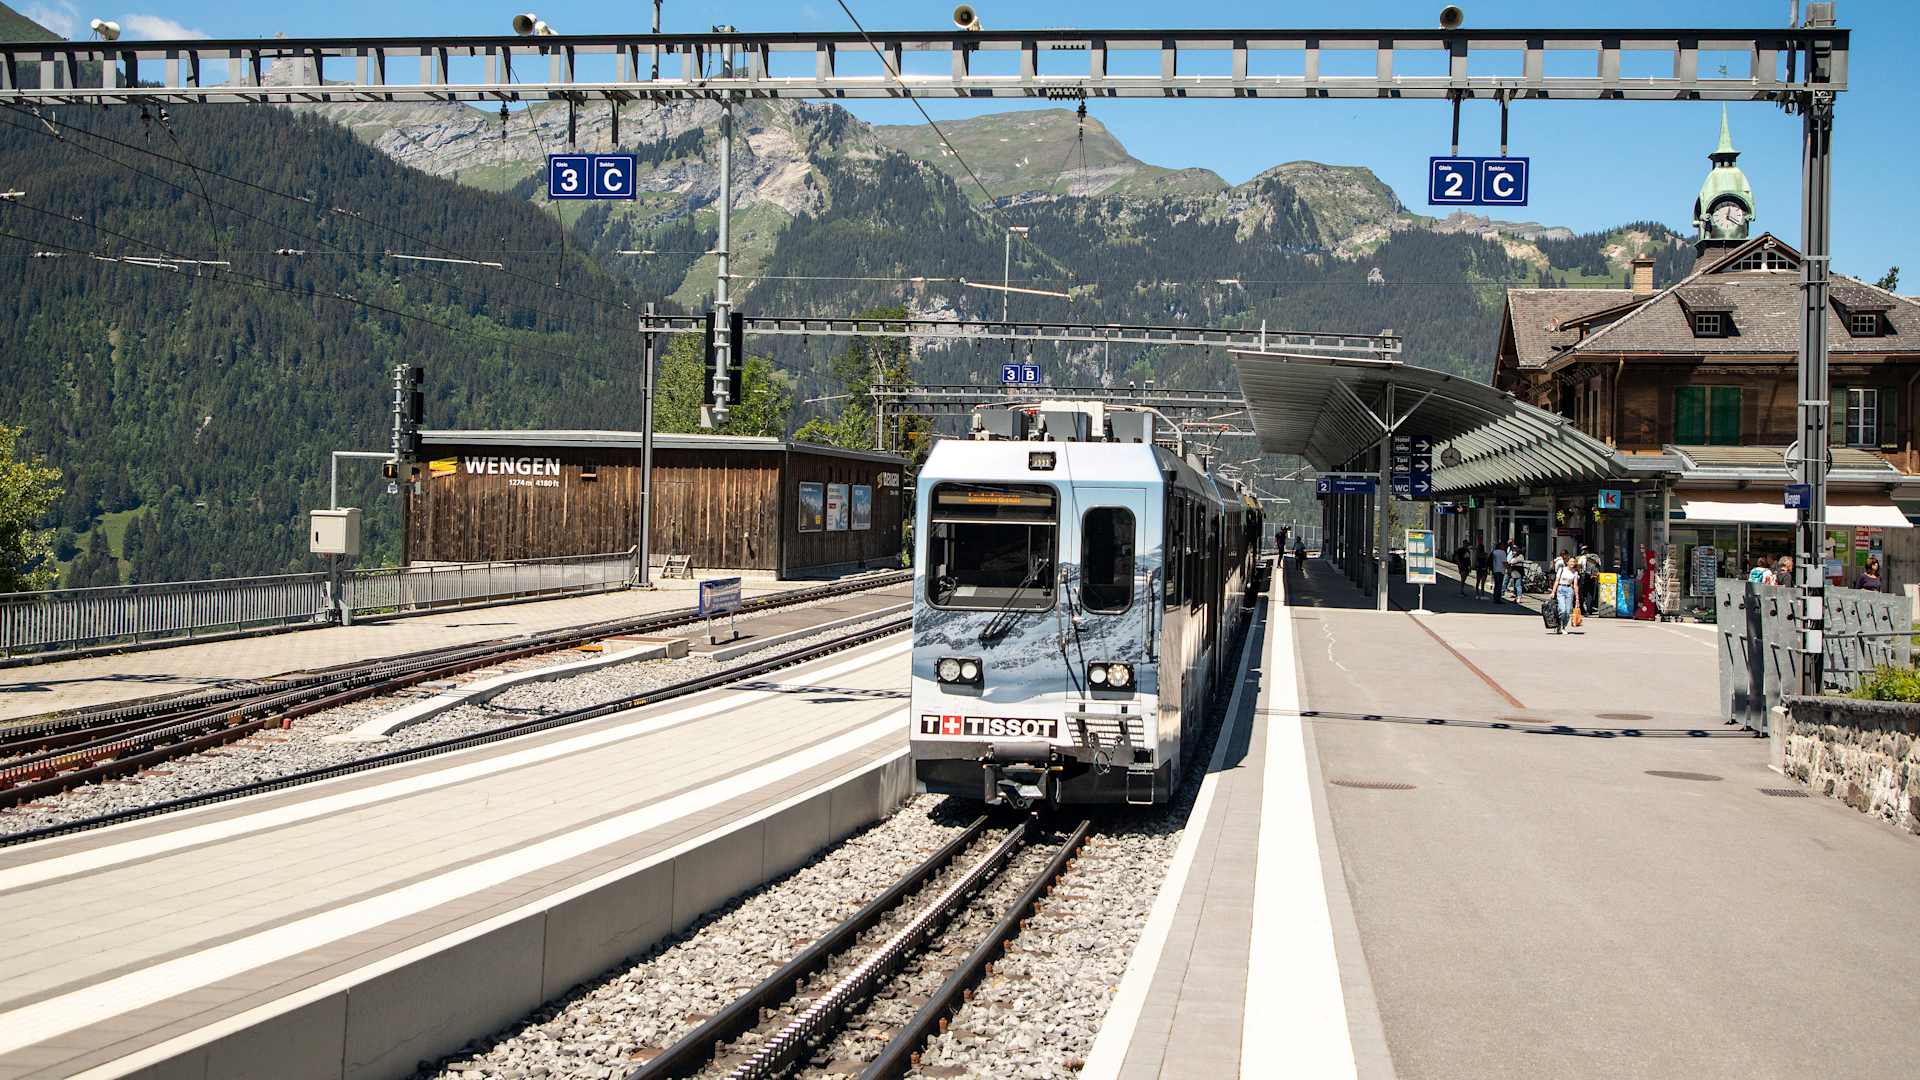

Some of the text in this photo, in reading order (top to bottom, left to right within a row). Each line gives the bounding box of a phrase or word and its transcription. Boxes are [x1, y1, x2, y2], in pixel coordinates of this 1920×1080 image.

[561, 168, 623, 192] 3 C
[1444, 172, 1514, 197] 2 C
[1007, 370, 1035, 381] 3 B
[464, 456, 560, 475] WENGEN
[1320, 483, 1328, 491] 2
[1394, 484, 1409, 492] WC
[966, 718, 1055, 737] TISSOT
